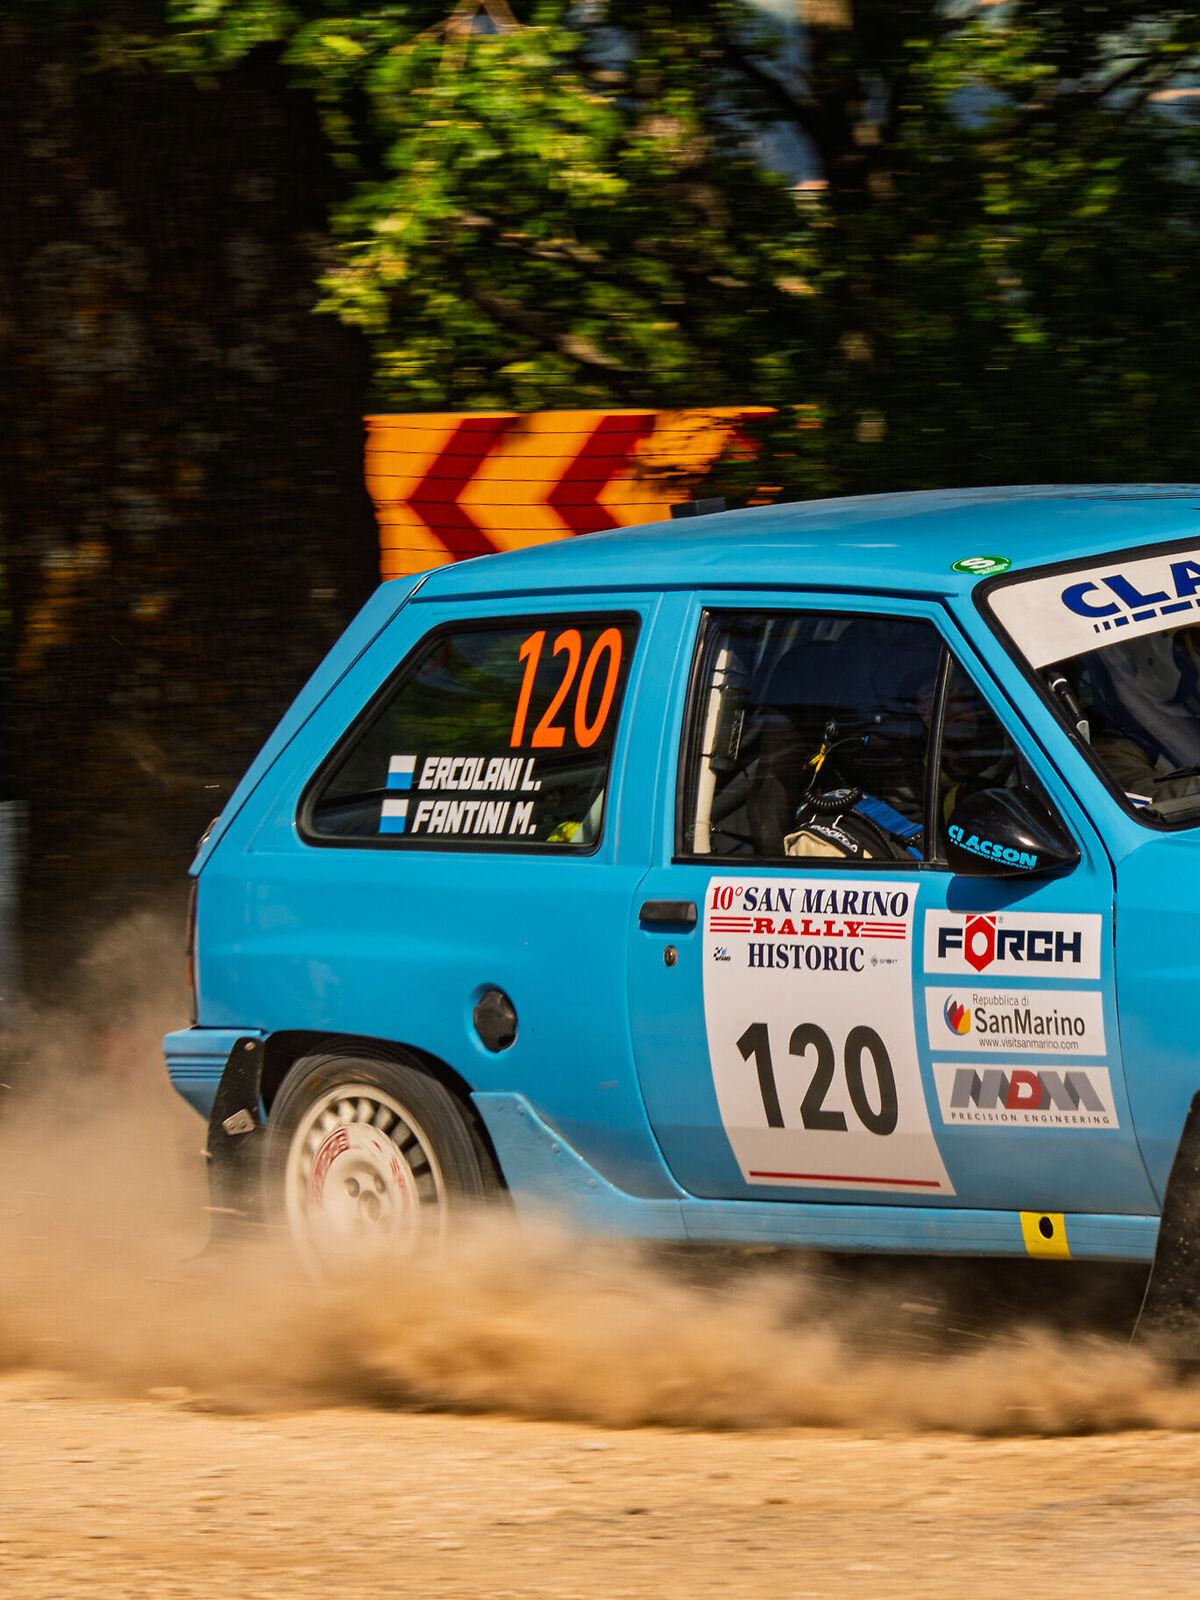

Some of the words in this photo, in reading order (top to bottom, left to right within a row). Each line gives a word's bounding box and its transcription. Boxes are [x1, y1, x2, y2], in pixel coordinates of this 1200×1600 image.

[510, 627, 622, 748] 120
[417, 757, 524, 791] ERCOLANI
[520, 757, 542, 791] L.
[410, 800, 511, 835] FANTINI
[508, 800, 537, 835] M.
[743, 886, 795, 913] SAN
[800, 888, 909, 918] MARINO
[753, 917, 864, 938] RALLY
[747, 942, 865, 973] HISTORIC
[972, 993, 1019, 1008] Repubblica
[1021, 994, 1029, 1006] di
[974, 1007, 1086, 1037] SanMarino
[978, 1037, 1079, 1050] www.visitsanmarino.com
[736, 1022, 899, 1136] 120
[950, 1068, 1106, 1112] MDM
[951, 1112, 1018, 1122] PRECISION
[1024, 1114, 1110, 1125] ENGINEERING
